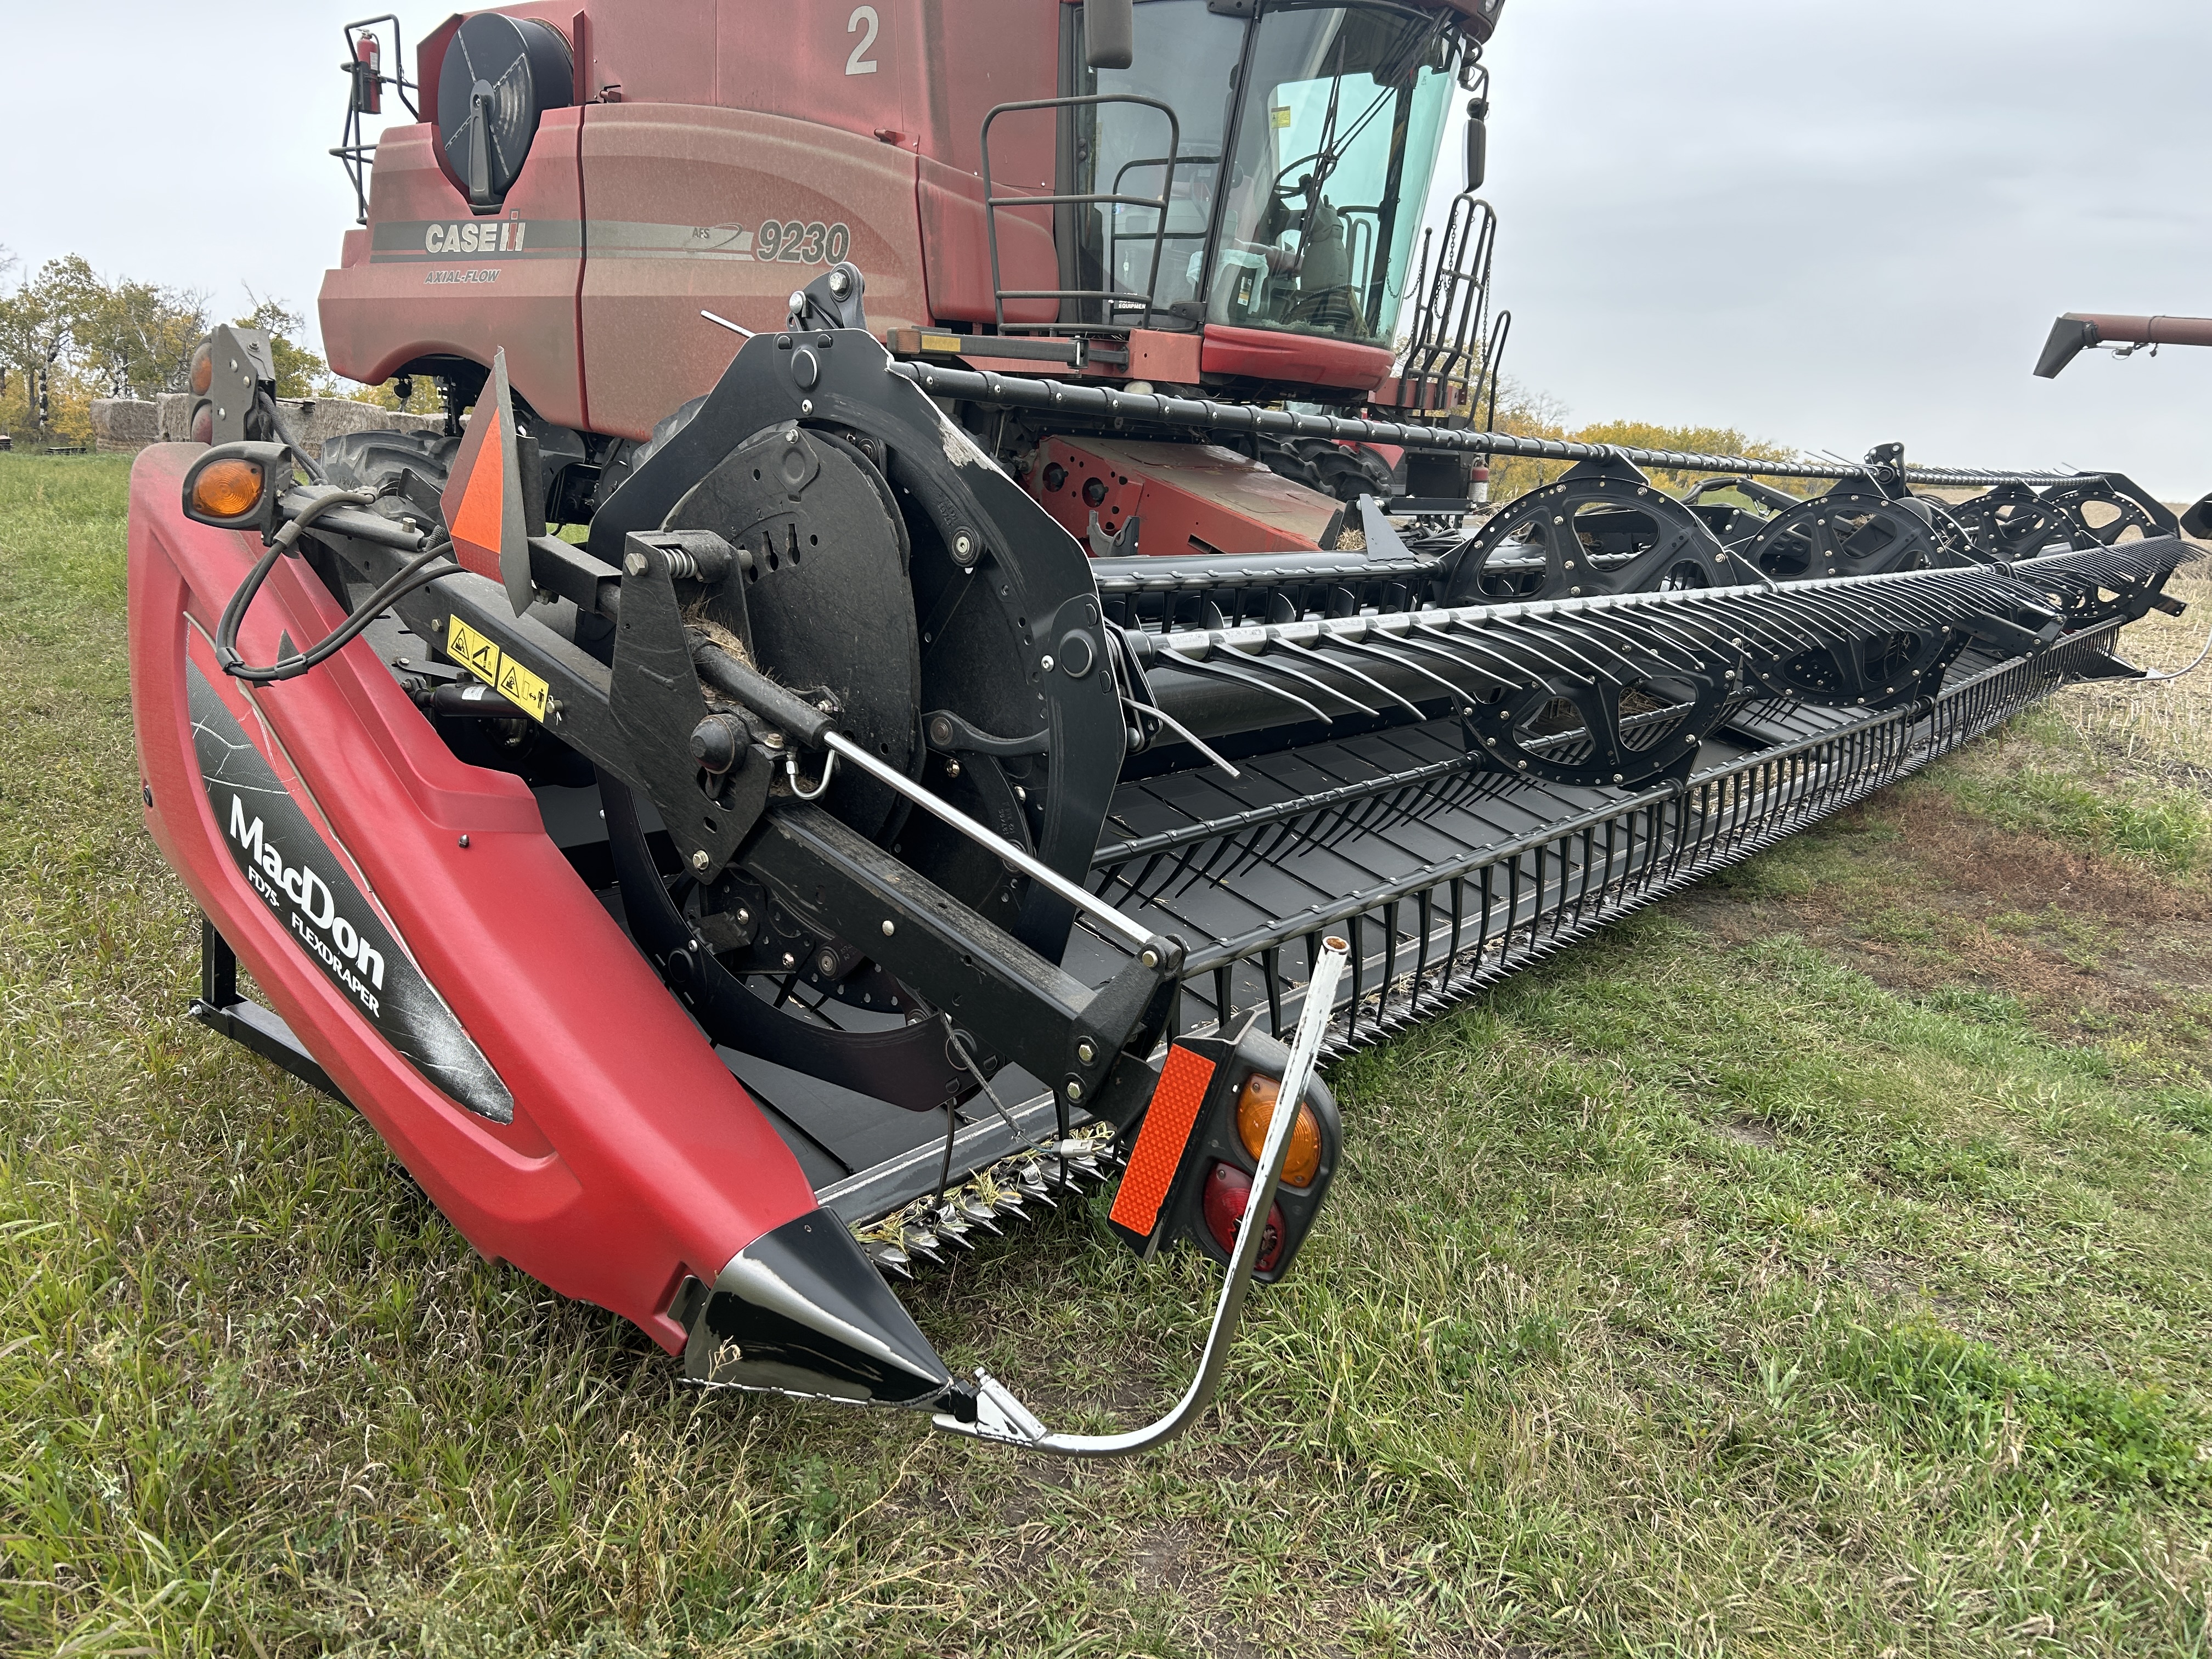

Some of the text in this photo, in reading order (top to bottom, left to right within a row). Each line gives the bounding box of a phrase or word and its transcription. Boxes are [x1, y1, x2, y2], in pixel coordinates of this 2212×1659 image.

[845, 5, 879, 75] 2
[426, 223, 498, 253] CASE
[692, 227, 710, 239] AFS
[757, 219, 850, 267] 9230
[424, 269, 501, 284] AXIAL-FLOW
[230, 793, 385, 990] MacDon
[292, 911, 380, 1018] FLEXDRAPER
